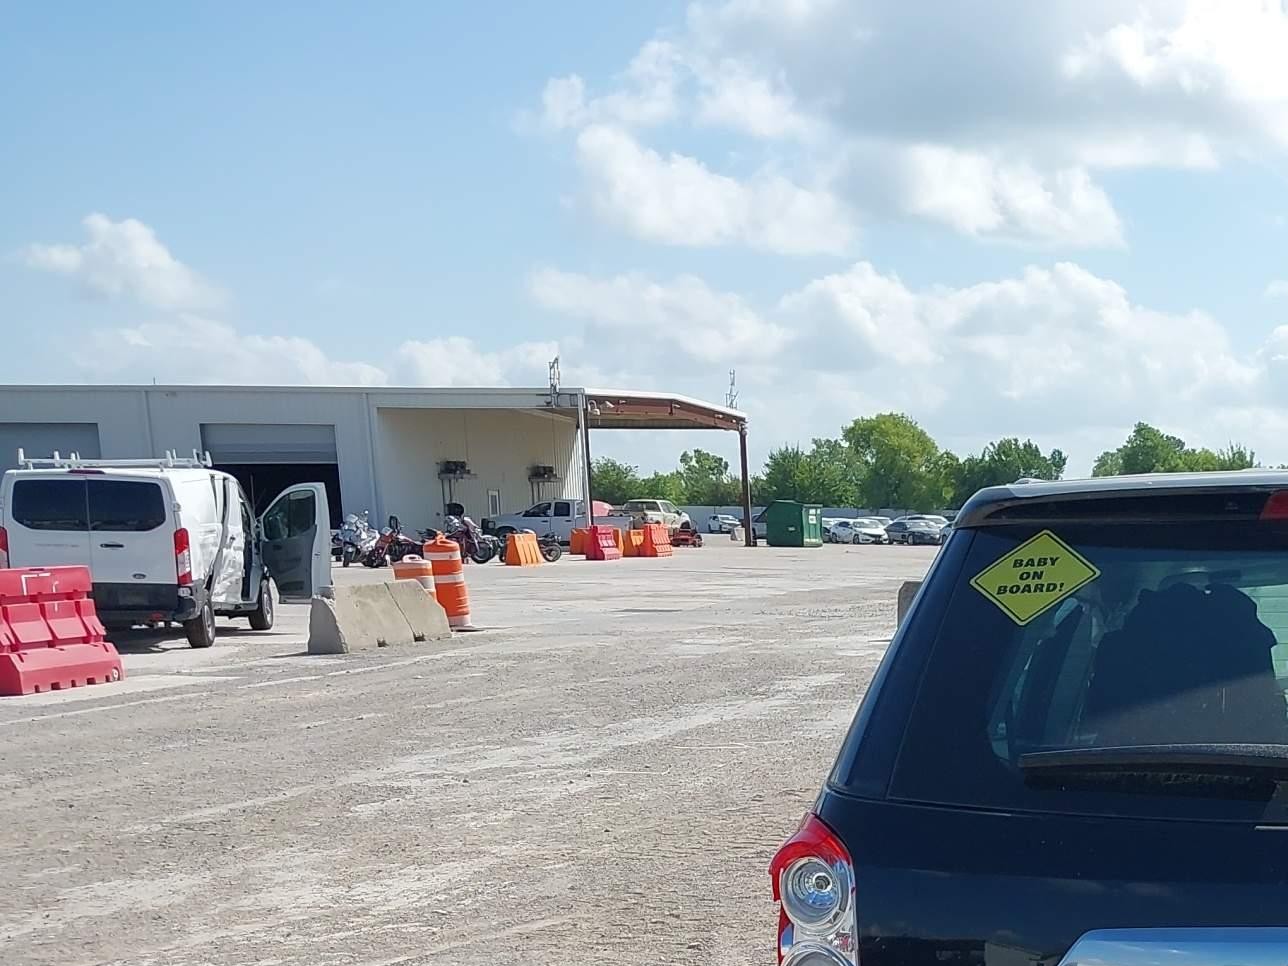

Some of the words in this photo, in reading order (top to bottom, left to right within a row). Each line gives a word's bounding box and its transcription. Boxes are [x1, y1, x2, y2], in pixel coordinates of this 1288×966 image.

[1012, 556, 1060, 569] BABY
[1018, 570, 1045, 581] ON
[996, 582, 1064, 595] BOARD!
